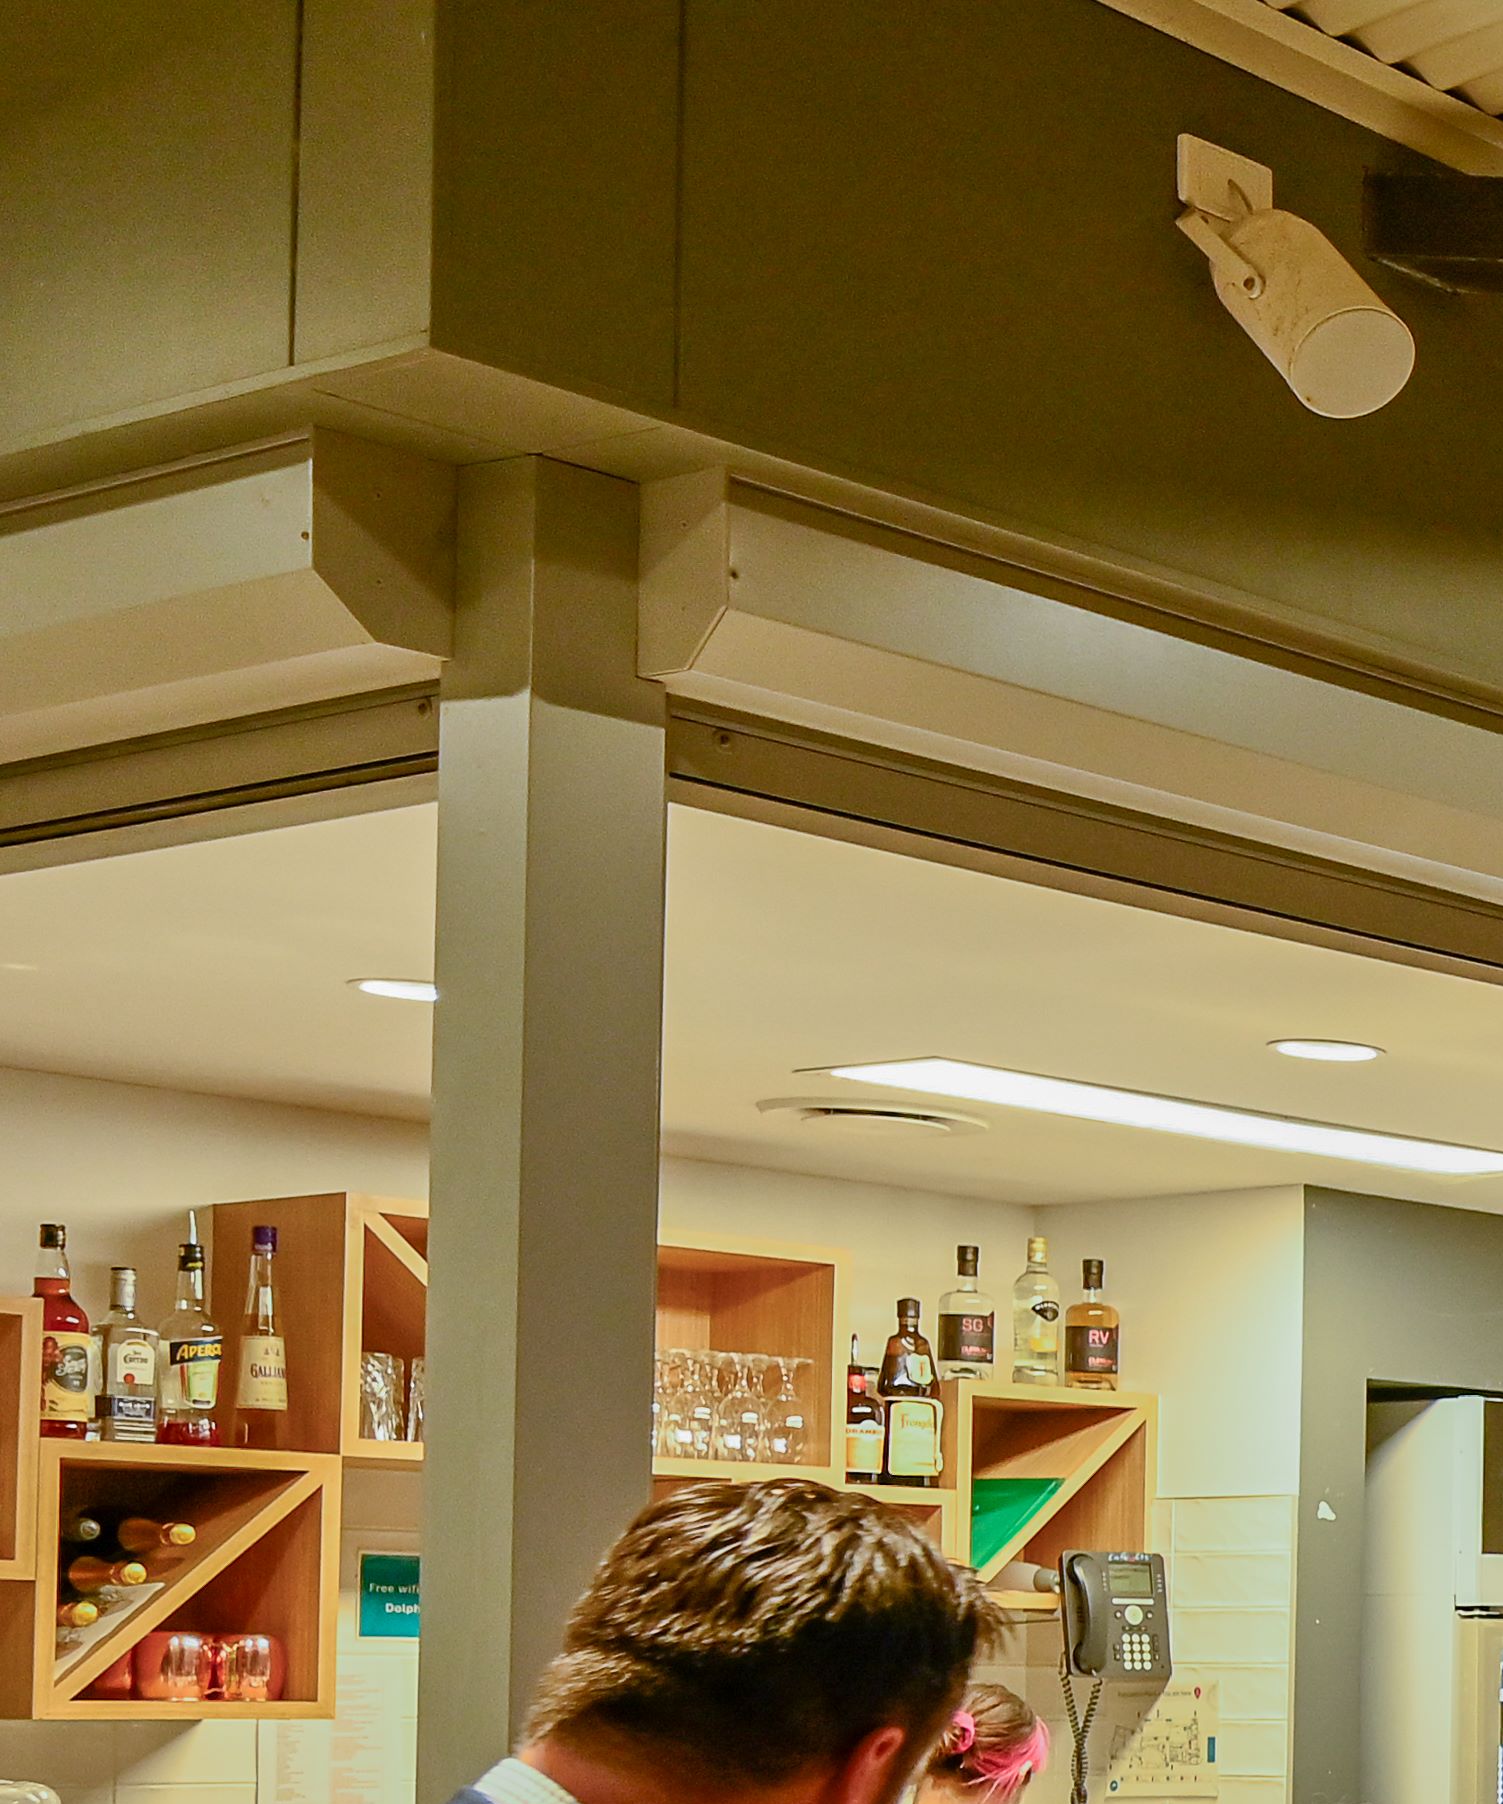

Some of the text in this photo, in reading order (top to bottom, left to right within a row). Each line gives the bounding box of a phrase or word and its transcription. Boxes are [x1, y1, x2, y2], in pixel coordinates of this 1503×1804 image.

[962, 1318, 984, 1333] SG
[1088, 1329, 1109, 1345] RV
[369, 1583, 395, 1593] Free
